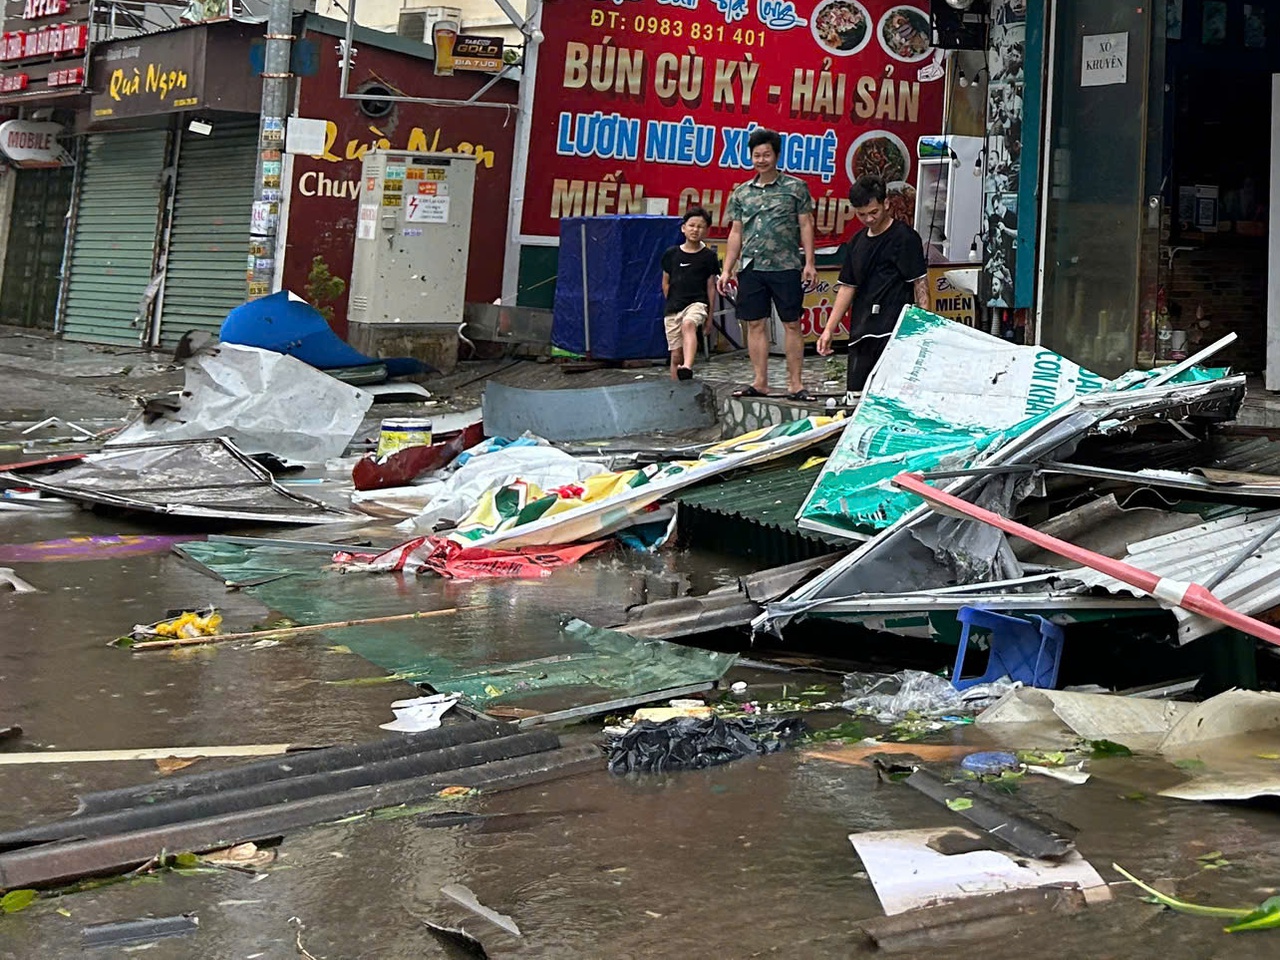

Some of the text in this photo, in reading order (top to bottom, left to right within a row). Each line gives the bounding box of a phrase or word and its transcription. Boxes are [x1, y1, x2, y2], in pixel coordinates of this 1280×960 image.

[590, 8, 766, 48] ĐT: 0983 831 401
[454, 59, 472, 67] BIA
[457, 43, 499, 55] GOLD
[1085, 54, 1124, 71] KHUYÊN
[109, 67, 141, 102] Quà
[145, 62, 188, 101] Ngon
[563, 32, 644, 96] BÚN
[653, 44, 705, 102] CÙ
[713, 52, 760, 106] KỲ
[791, 56, 846, 117] HẢI
[854, 63, 921, 123] SẢN
[7, 130, 53, 151] MOBILE
[407, 127, 495, 169] Non
[556, 110, 641, 159] LƯƠN
[644, 115, 716, 166] NIÊU
[549, 170, 856, 235] MIẾN CHÁ ÚP
[935, 293, 973, 313] MIẾN
